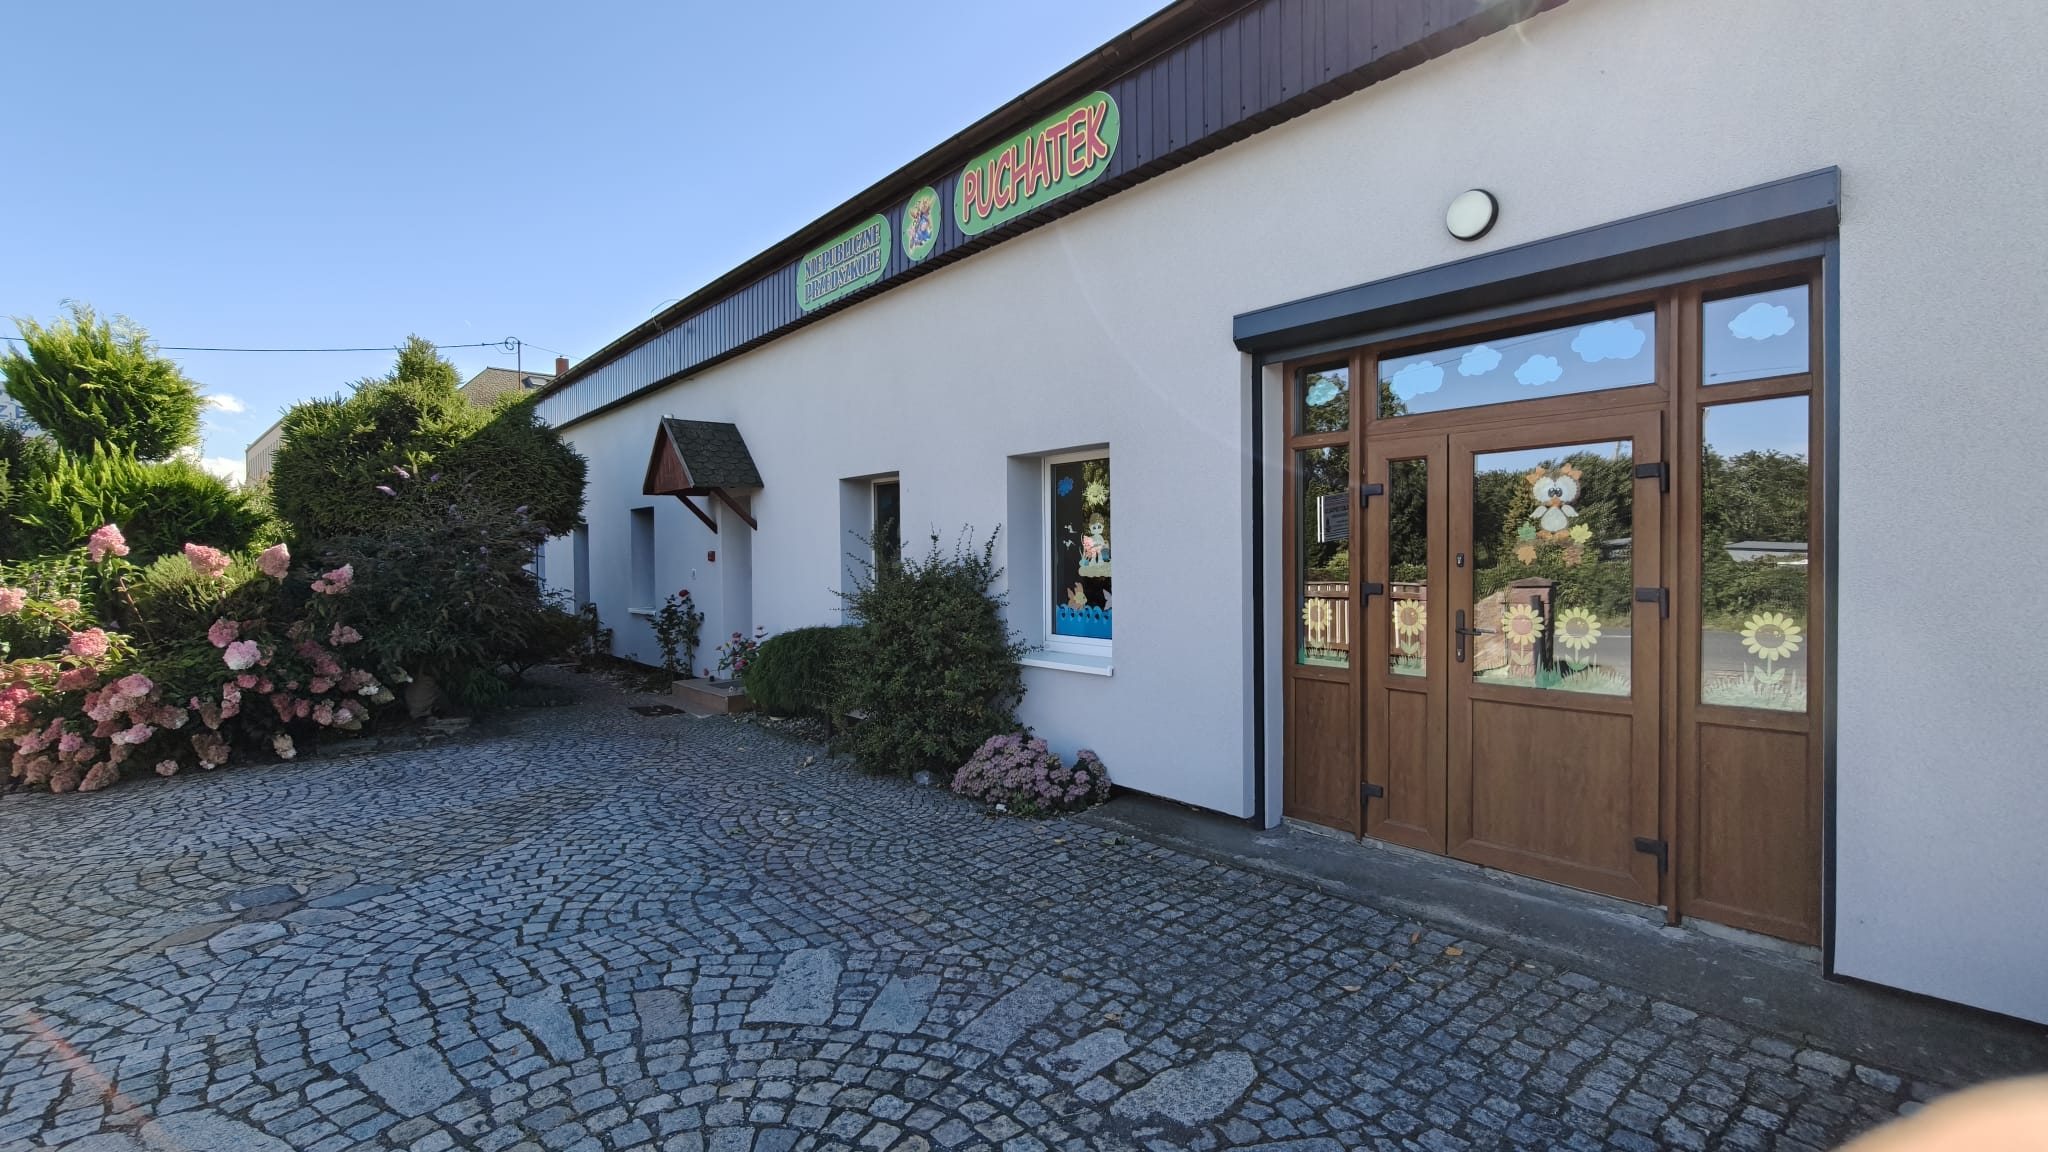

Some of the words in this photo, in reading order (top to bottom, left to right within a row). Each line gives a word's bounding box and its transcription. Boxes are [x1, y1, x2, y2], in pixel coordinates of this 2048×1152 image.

[963, 101, 1107, 222] PUCHATEK
[805, 223, 880, 281] NIEPUBLICZNE
[805, 248, 880, 304] PRZEDSZKOLE
